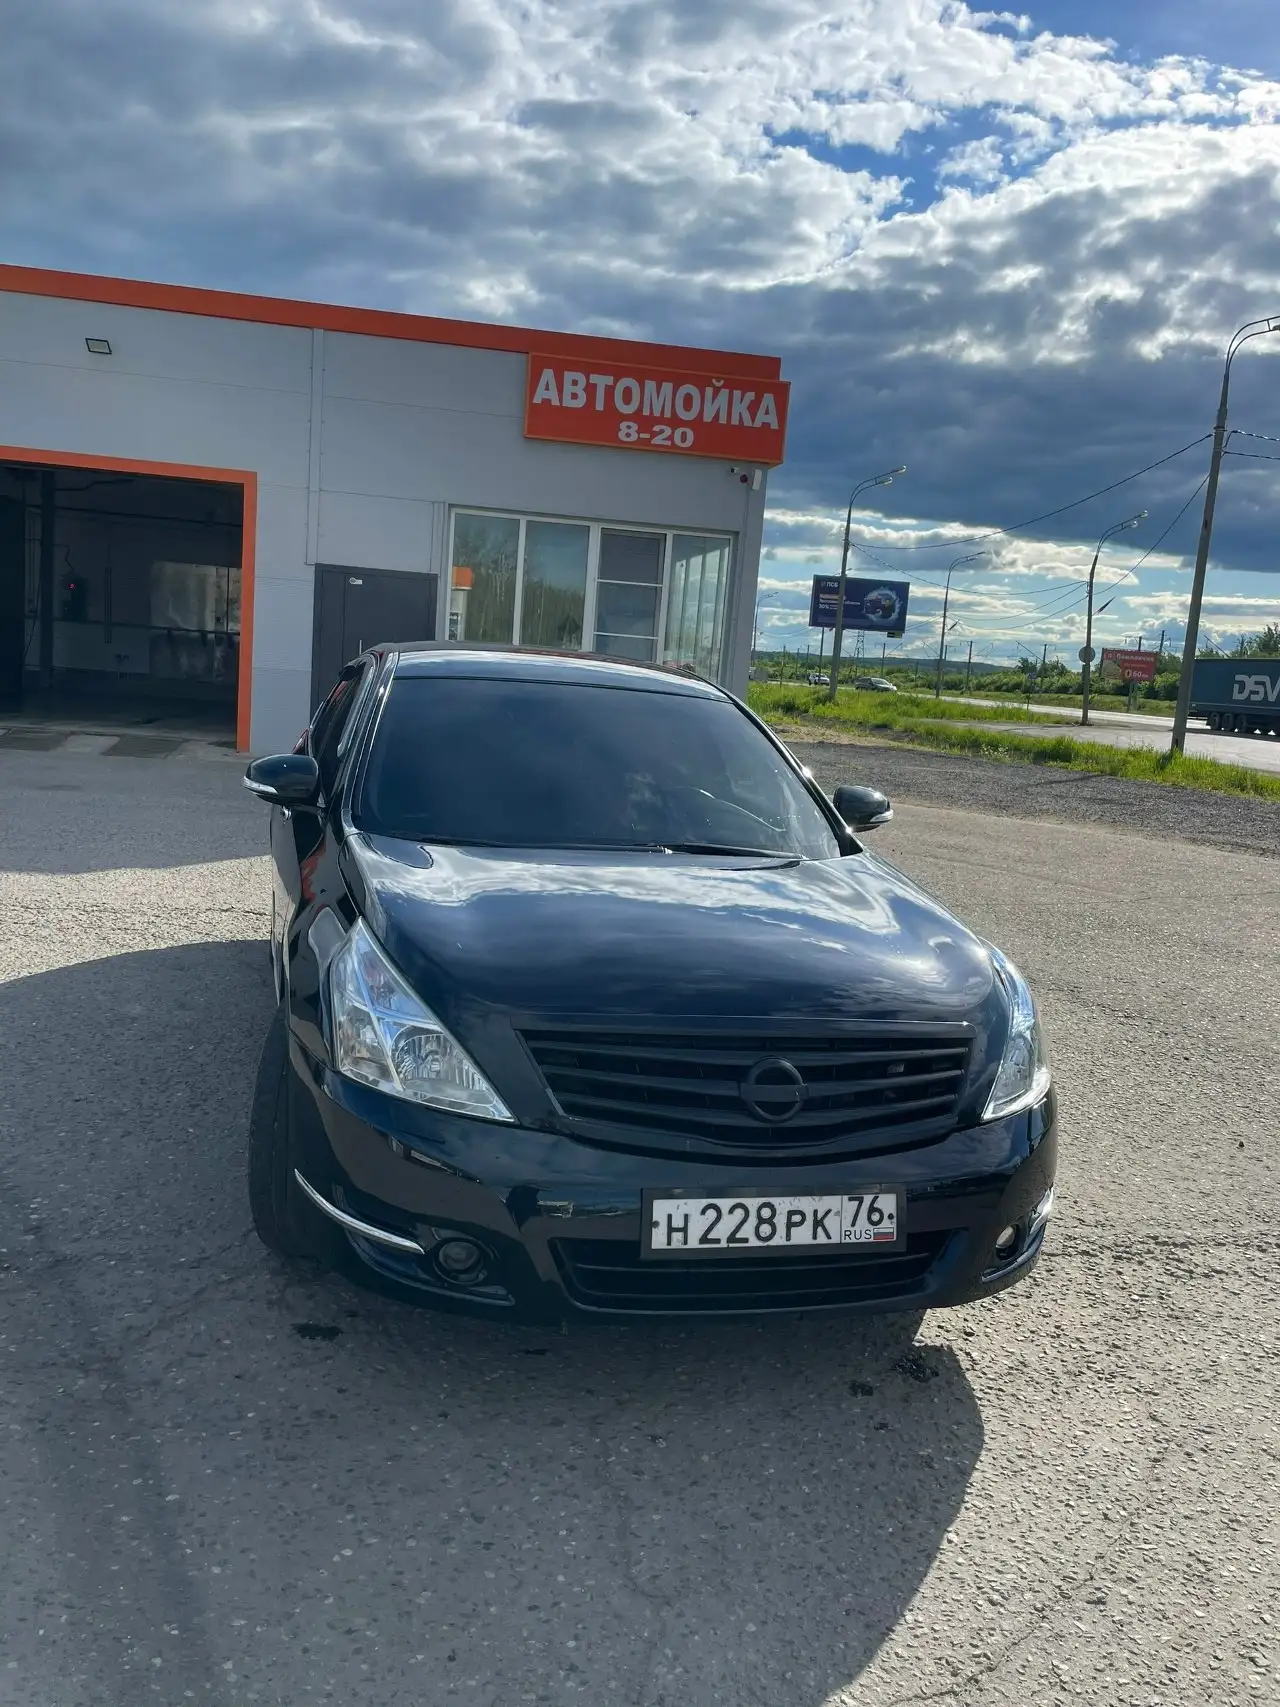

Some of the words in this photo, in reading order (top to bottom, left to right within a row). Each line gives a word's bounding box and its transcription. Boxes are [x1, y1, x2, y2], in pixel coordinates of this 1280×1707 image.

[532, 368, 779, 430] АВТОМОЙКА
[617, 421, 694, 448] 8-20
[1232, 674, 1280, 702] DSV
[666, 1201, 833, 1247] Н228РК
[848, 1195, 885, 1228] 76
[844, 1229, 872, 1241] RUS
